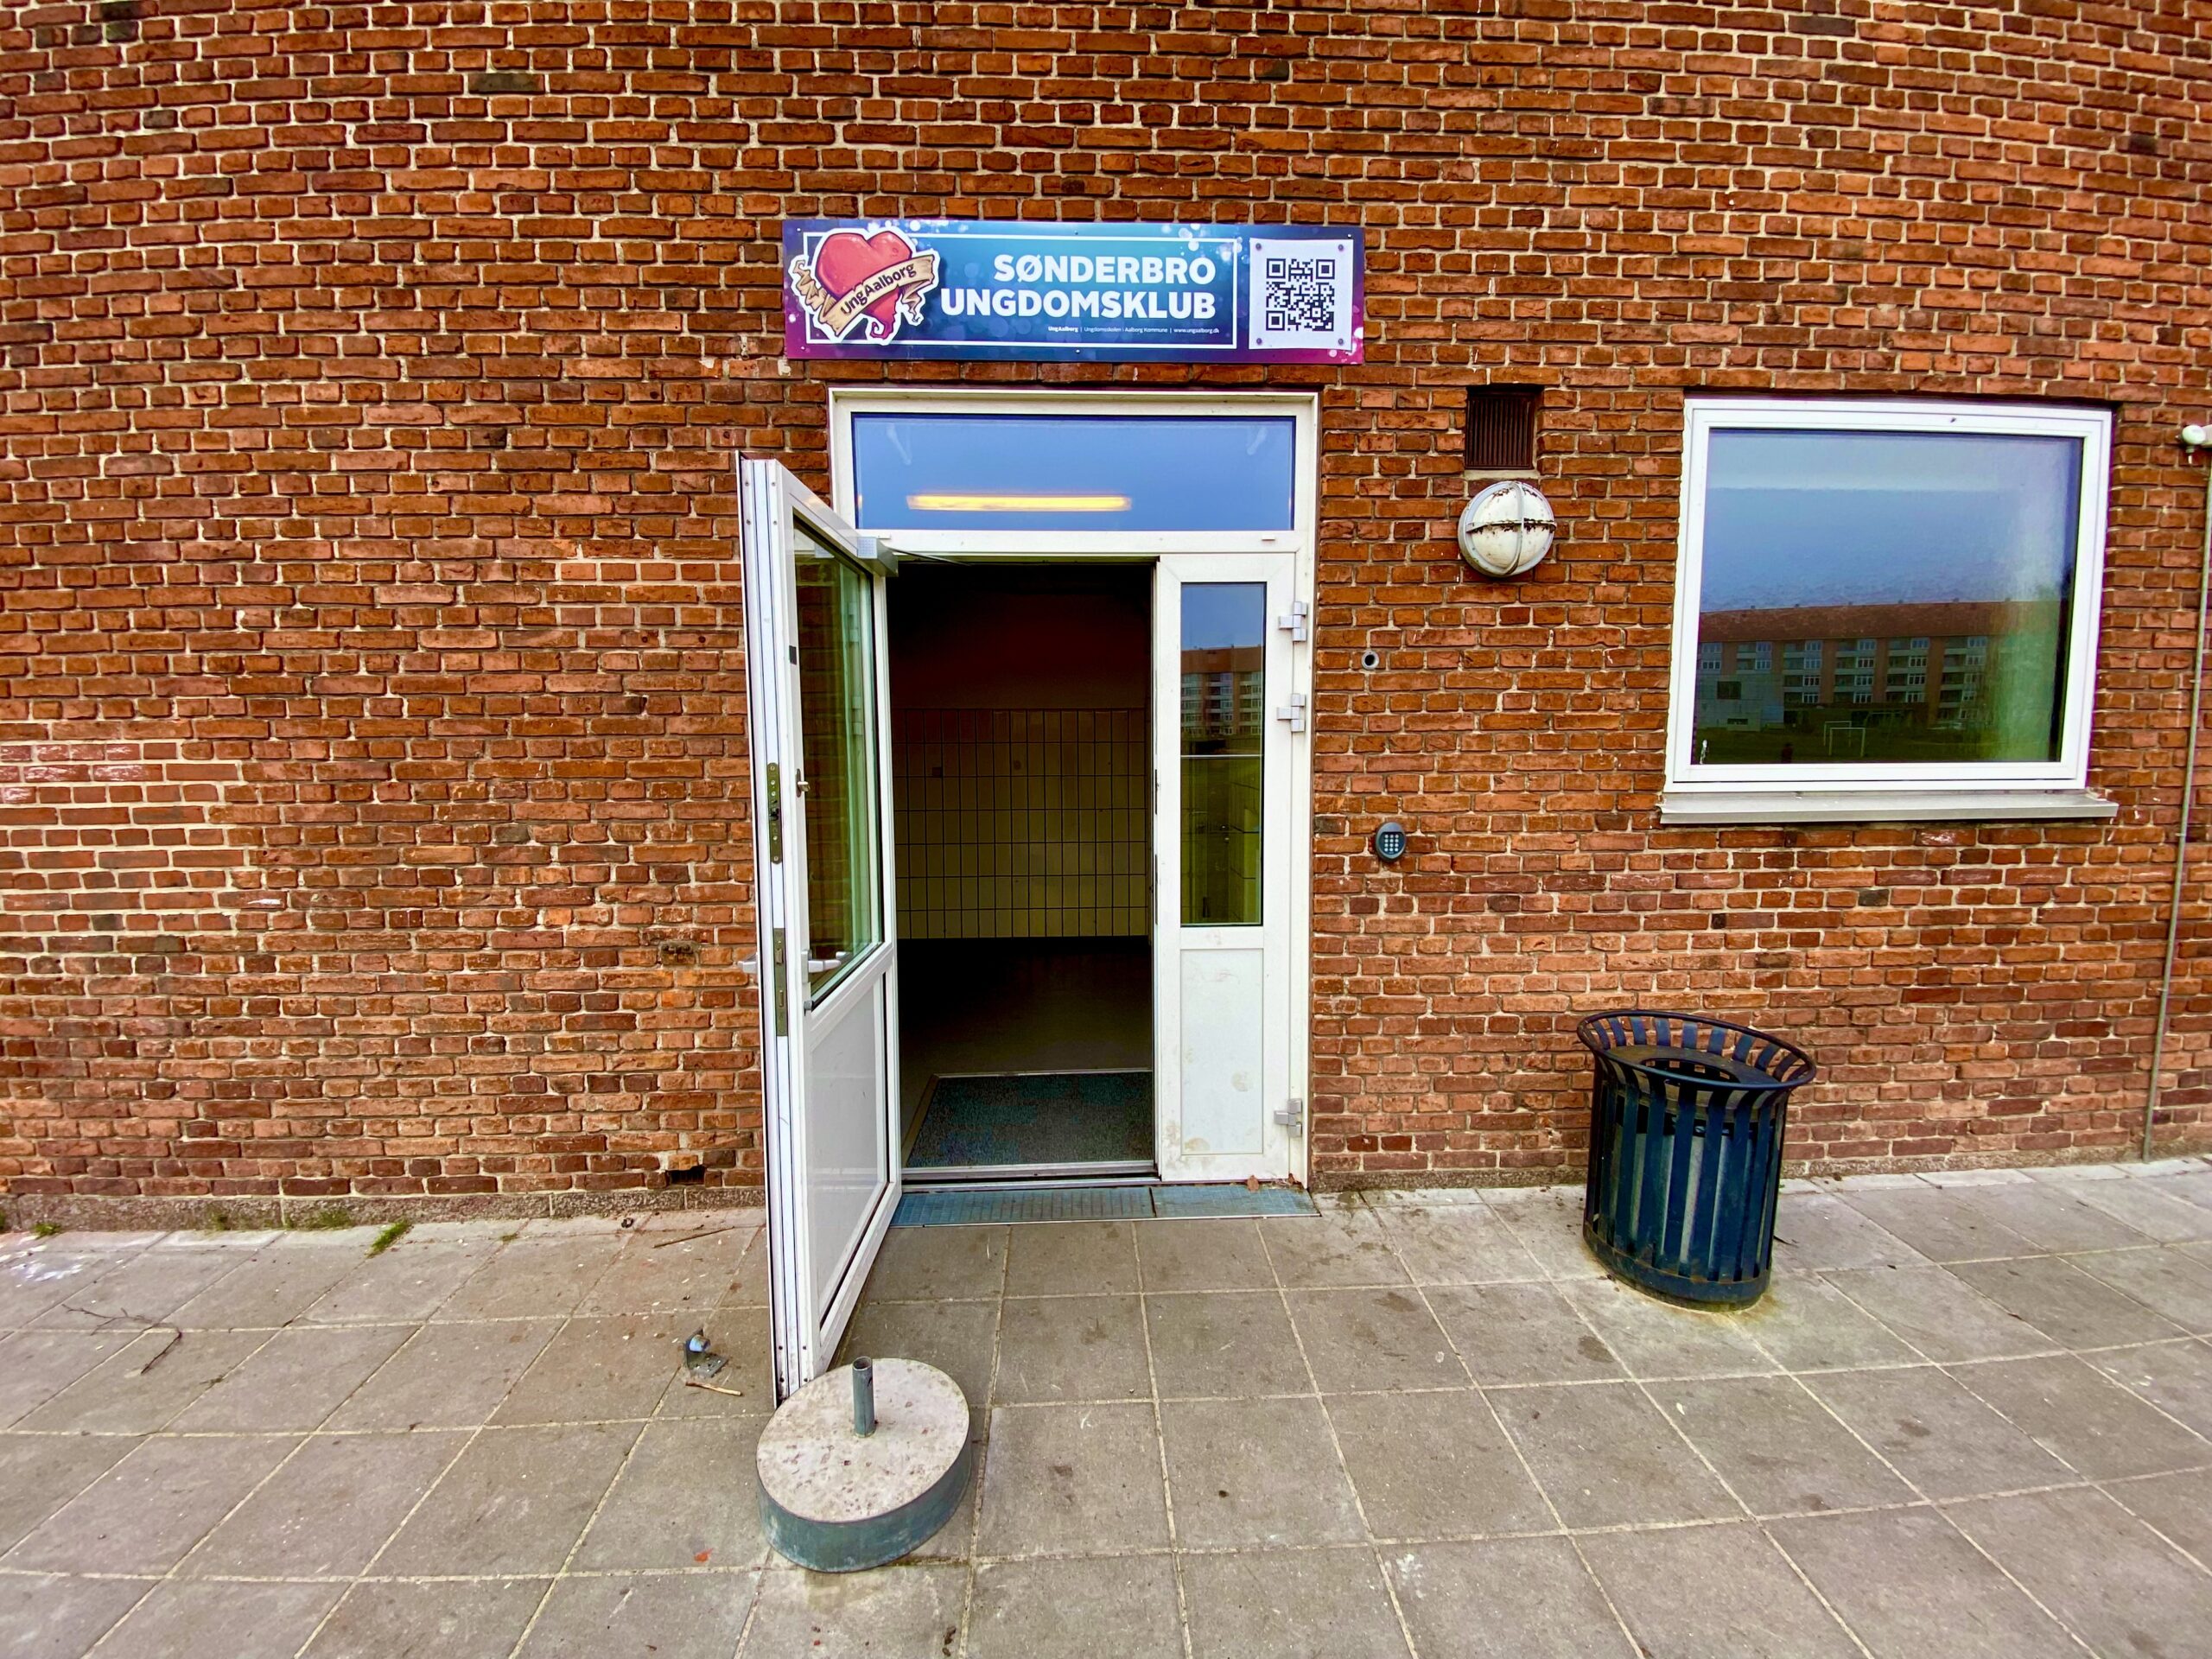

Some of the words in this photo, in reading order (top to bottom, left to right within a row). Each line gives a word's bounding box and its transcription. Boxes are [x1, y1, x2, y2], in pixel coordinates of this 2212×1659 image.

[994, 254, 1217, 284] SØNDERBRO
[841, 263, 916, 315] UngAalborg
[941, 288, 1217, 319] UNGDOMSKLUB
